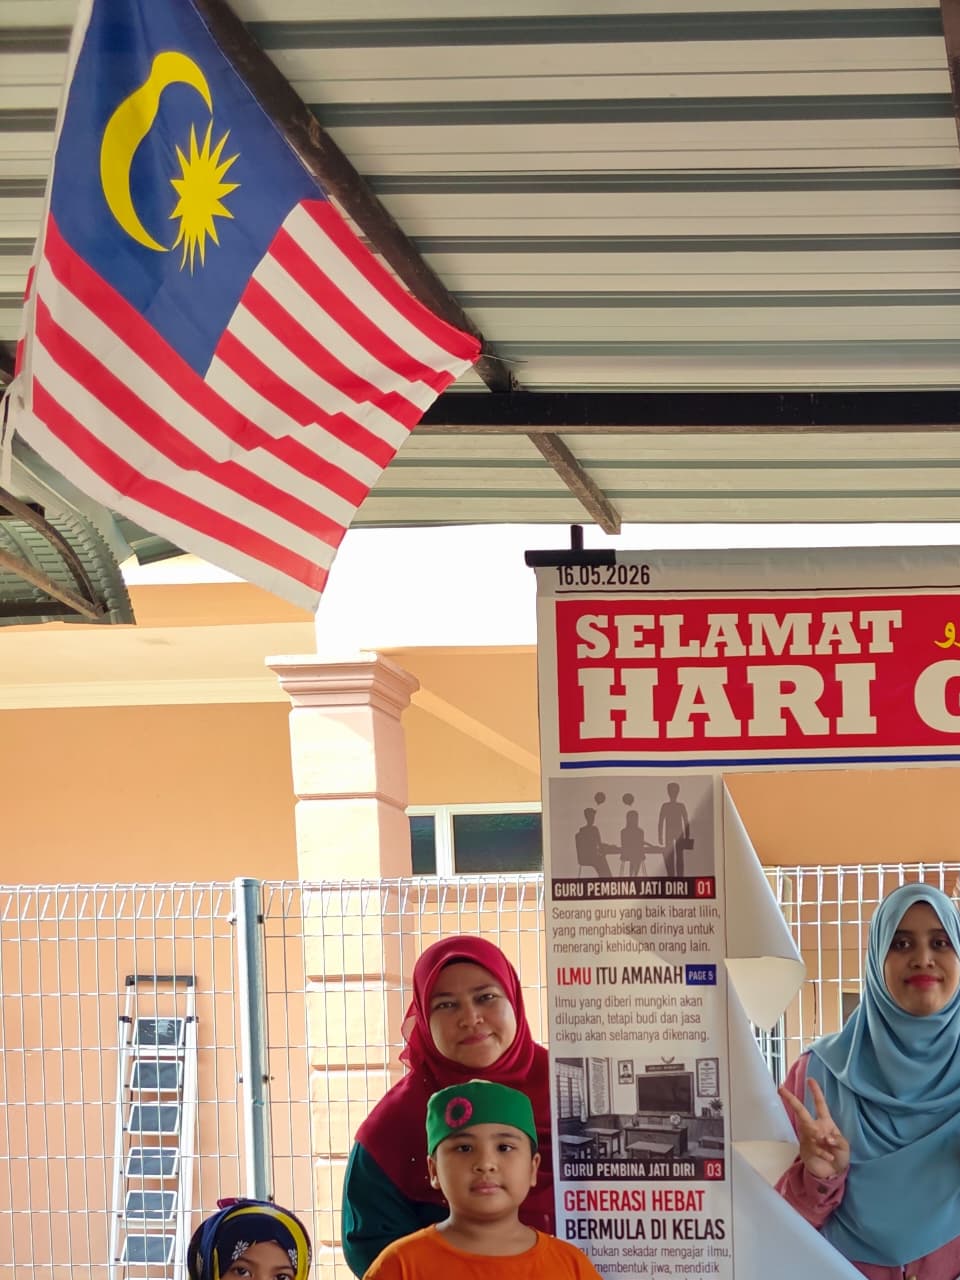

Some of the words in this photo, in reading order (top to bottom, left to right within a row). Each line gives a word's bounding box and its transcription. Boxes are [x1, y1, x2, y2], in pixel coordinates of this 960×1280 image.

[556, 565, 650, 585] 16.05.2026
[576, 609, 902, 659] SELAMAT
[577, 662, 878, 740] HARI
[554, 882, 584, 897] GURU
[587, 881, 636, 897] PEMBINA
[639, 881, 662, 896] JATI
[665, 881, 688, 896] DIRI
[697, 881, 711, 895] 01
[552, 907, 592, 921] Seorang
[594, 909, 617, 921] guru
[619, 909, 643, 920] yang
[645, 905, 666, 919] baik
[668, 905, 697, 918] ibarat
[699, 905, 721, 919] lilin,
[552, 926, 576, 938] yang
[579, 923, 647, 937] menghabiskan
[650, 922, 684, 936] dirinya
[687, 922, 715, 935] untuk
[553, 941, 604, 955] menerangi
[606, 940, 656, 954] kehidupan
[658, 941, 687, 954] orang
[690, 940, 711, 952] lain.
[557, 967, 592, 986] ILMU
[596, 966, 617, 985] ITU
[622, 966, 683, 985] AMANAH
[688, 970, 707, 981] PAGE
[555, 995, 577, 1008] Ilmu
[579, 997, 602, 1010] yang
[604, 995, 631, 1008] diberi
[635, 995, 677, 1009] mungkin
[680, 995, 703, 1007] akan
[555, 1013, 604, 1026] dilupakan,
[607, 1012, 633, 1026] tetapi
[636, 1011, 657, 1024] budi
[660, 1011, 678, 1024] dan
[680, 1011, 701, 1026] jasa
[555, 1030, 582, 1043] cikgu
[585, 1029, 607, 1041] akan
[609, 1029, 660, 1043] selamanya
[662, 1028, 710, 1043] dikenang.
[563, 1163, 593, 1177] GURU
[597, 1163, 645, 1177] PEMBINA
[648, 1163, 670, 1177] JATI
[673, 1163, 695, 1177] DIRI
[707, 1163, 722, 1177] 03
[563, 1190, 646, 1212] GENERASI
[652, 1190, 705, 1211] HEBAT
[565, 1219, 645, 1240] BERMULA
[651, 1219, 667, 1240] DI
[672, 1218, 726, 1240] KELAS
[592, 1245, 619, 1257] bukan
[622, 1245, 658, 1257] sekadar
[660, 1246, 704, 1260] mengajar
[706, 1245, 732, 1259] ilmu,
[594, 1262, 648, 1273] membentuk
[651, 1262, 673, 1276] jiwa,
[675, 1262, 719, 1273] mendidik
